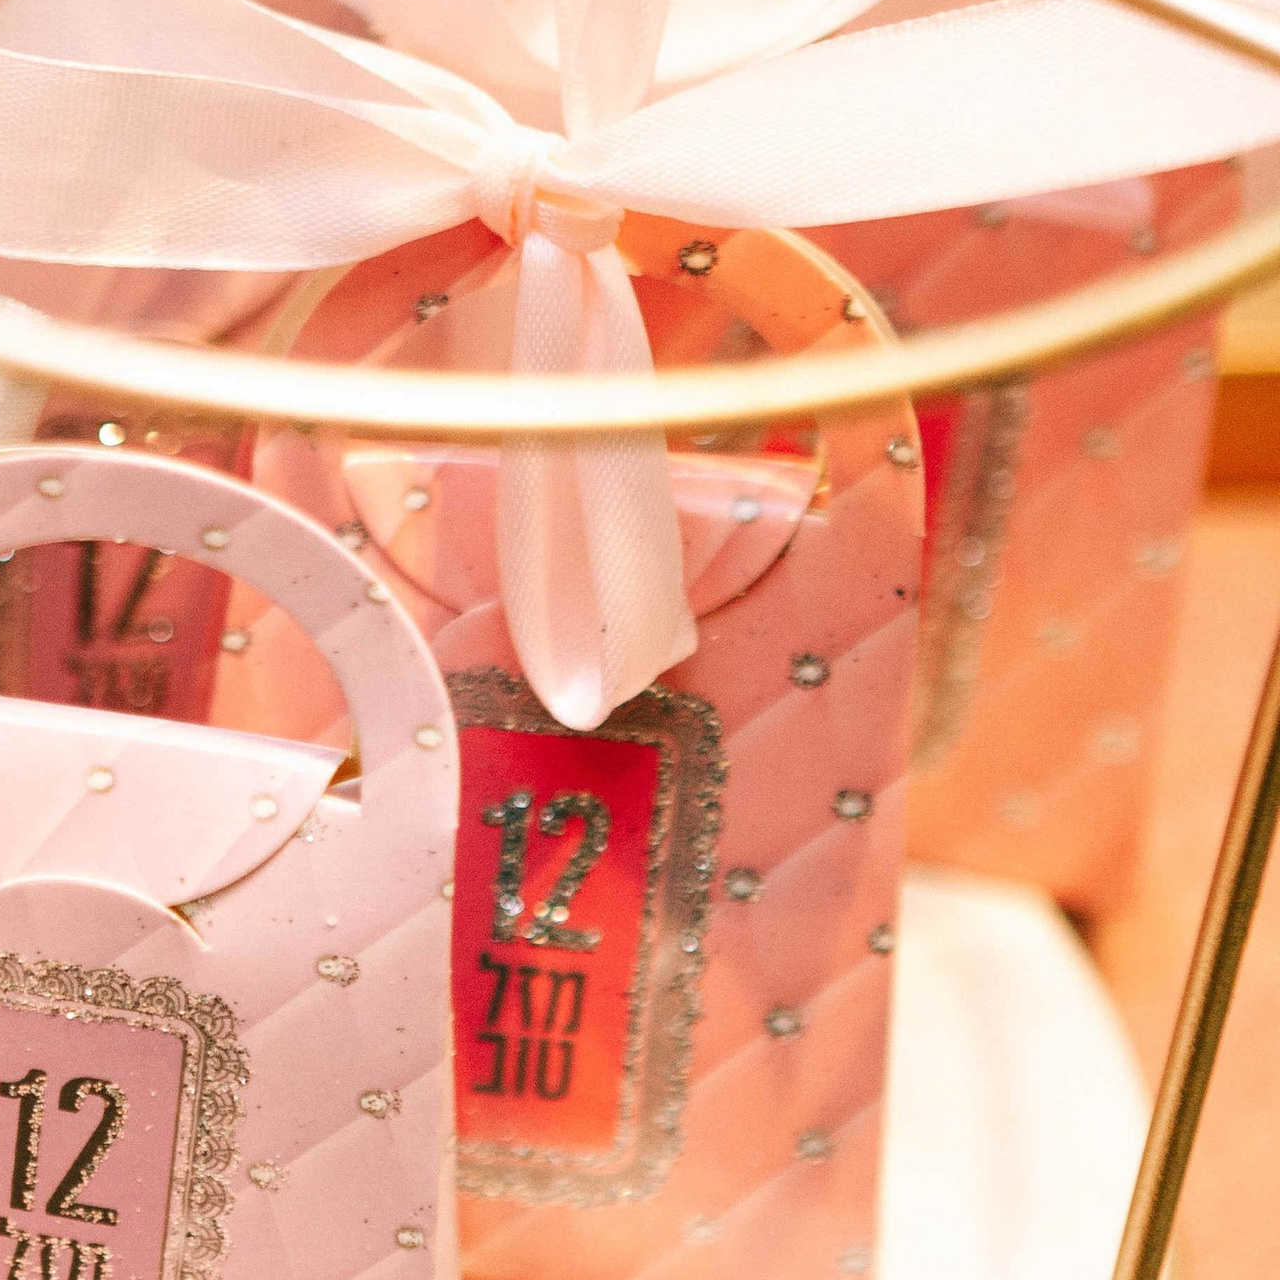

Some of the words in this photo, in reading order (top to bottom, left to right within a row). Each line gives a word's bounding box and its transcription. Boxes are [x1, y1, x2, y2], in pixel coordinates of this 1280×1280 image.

[482, 791, 612, 953] 12
[479, 951, 587, 1034] מזל
[472, 1030, 575, 1101] טוב
